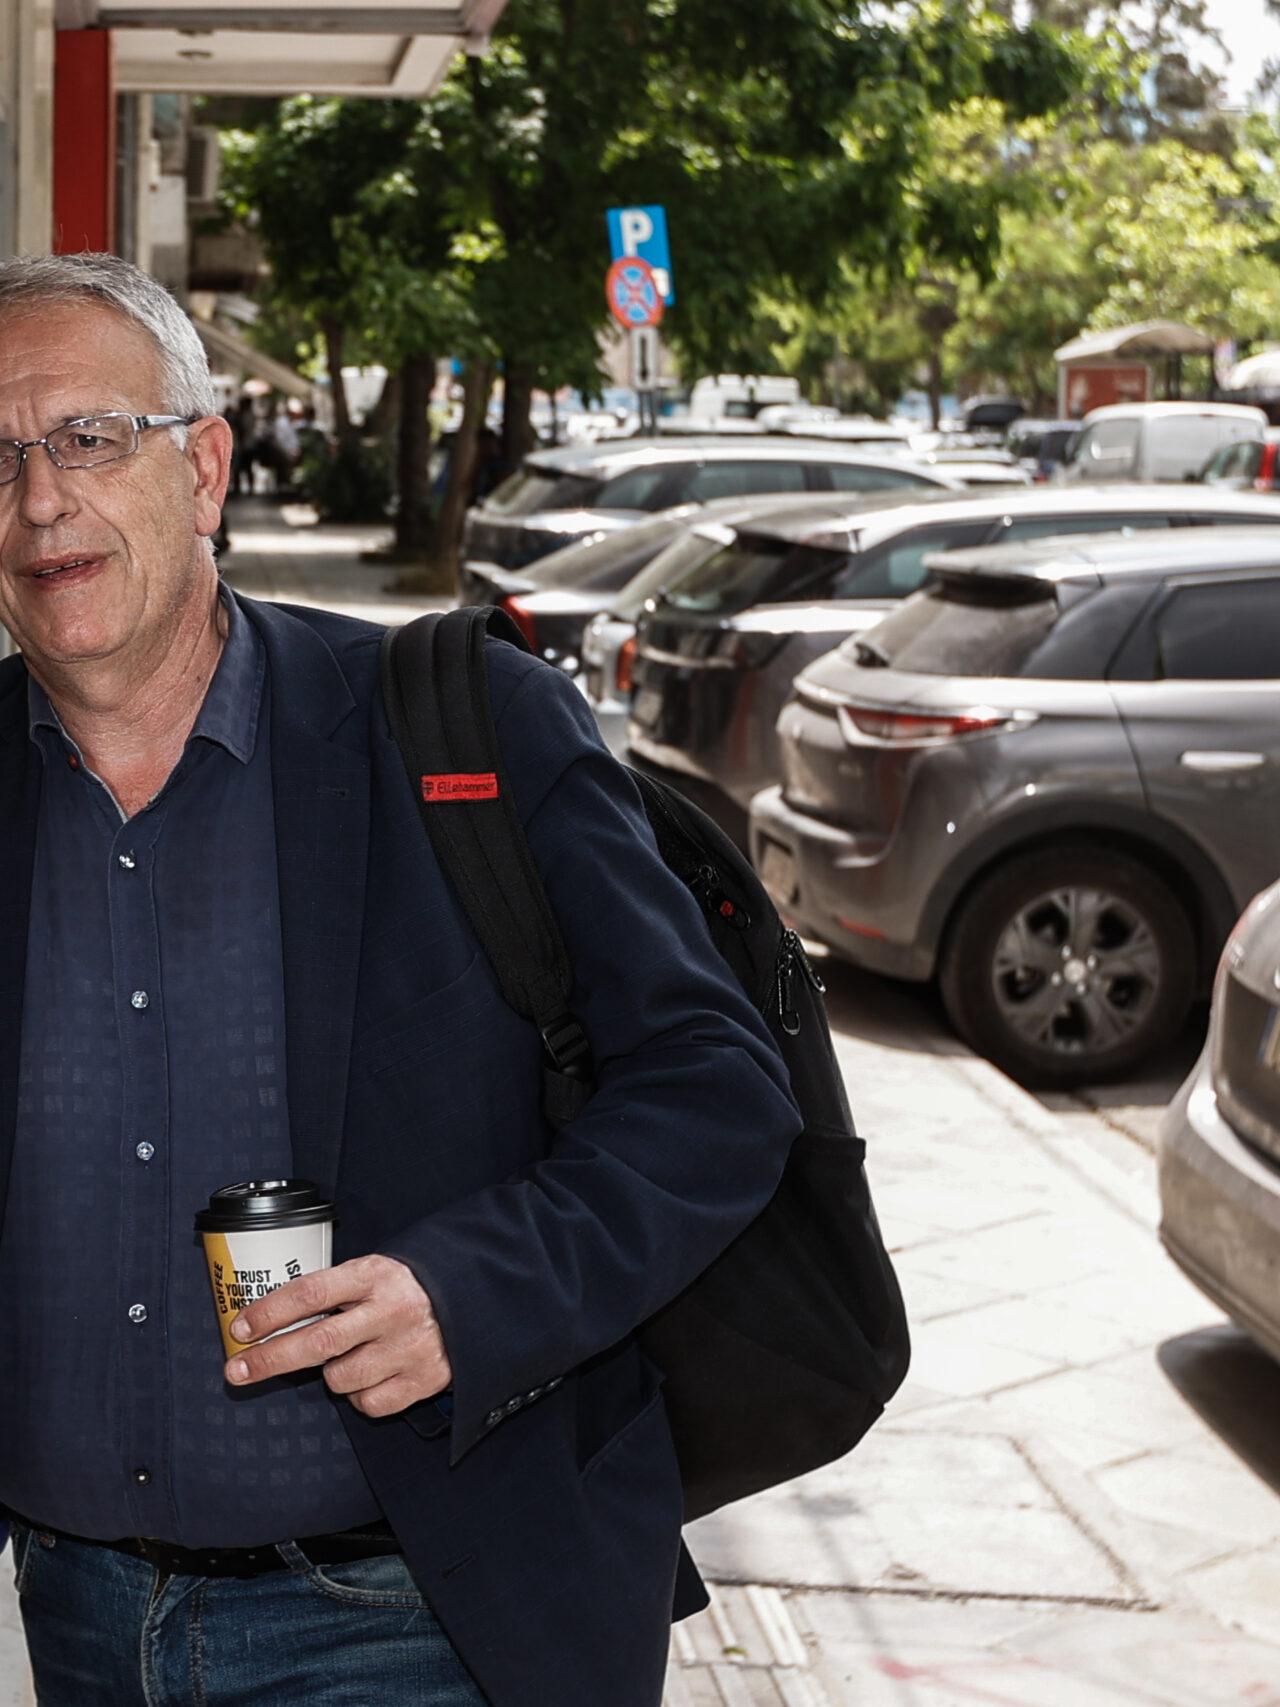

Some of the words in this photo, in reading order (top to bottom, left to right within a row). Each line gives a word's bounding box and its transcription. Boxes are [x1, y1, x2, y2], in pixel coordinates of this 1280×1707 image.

[620, 208, 653, 257] P
[233, 1269, 271, 1283] TRUST
[213, 1261, 228, 1314] COFFEE
[225, 1284, 253, 1297] YOUR
[230, 1297, 262, 1311] INST
